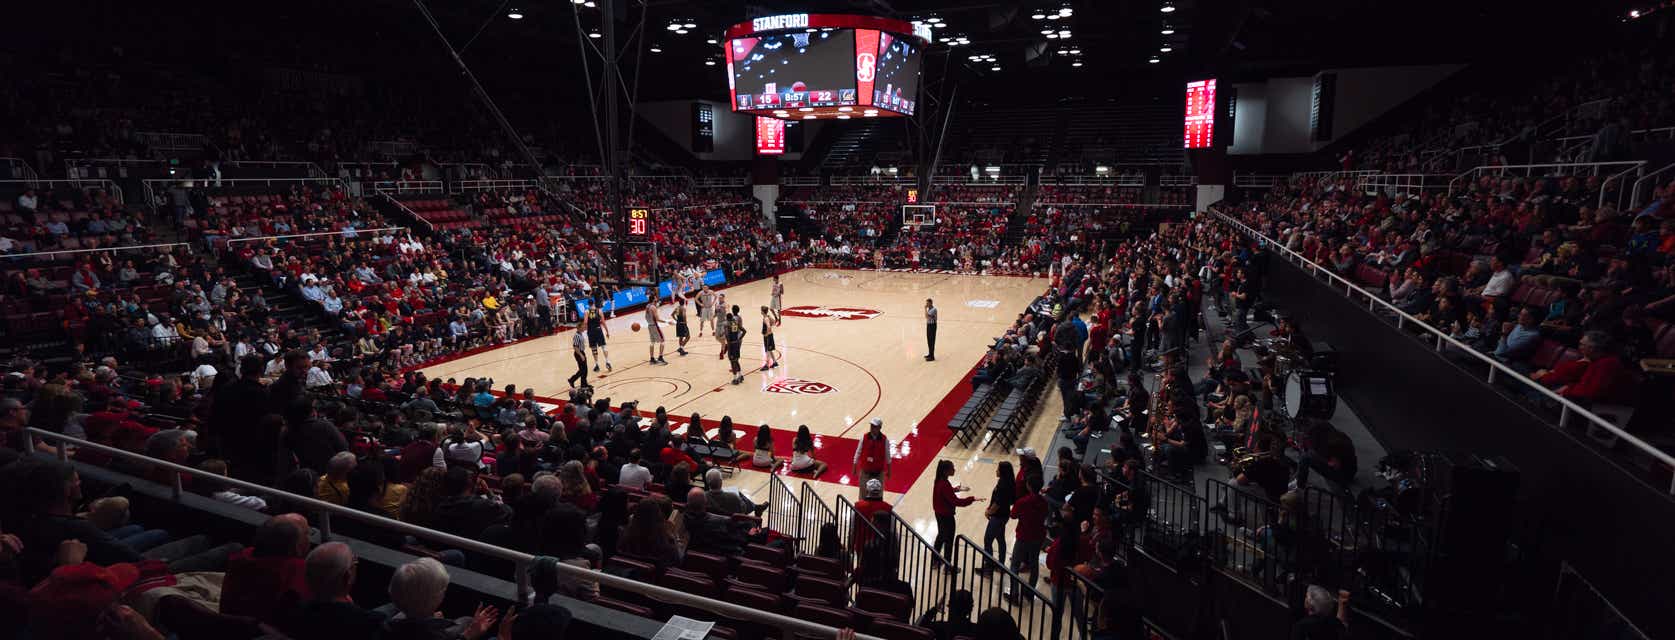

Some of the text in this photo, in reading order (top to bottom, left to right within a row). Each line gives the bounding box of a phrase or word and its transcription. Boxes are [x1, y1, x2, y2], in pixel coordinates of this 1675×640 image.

[753, 14, 808, 31] STANFORD
[760, 95, 771, 103] 15
[785, 93, 804, 101] 8:57
[818, 91, 832, 100] 22
[631, 210, 648, 218] 8:57
[630, 219, 645, 234] 30
